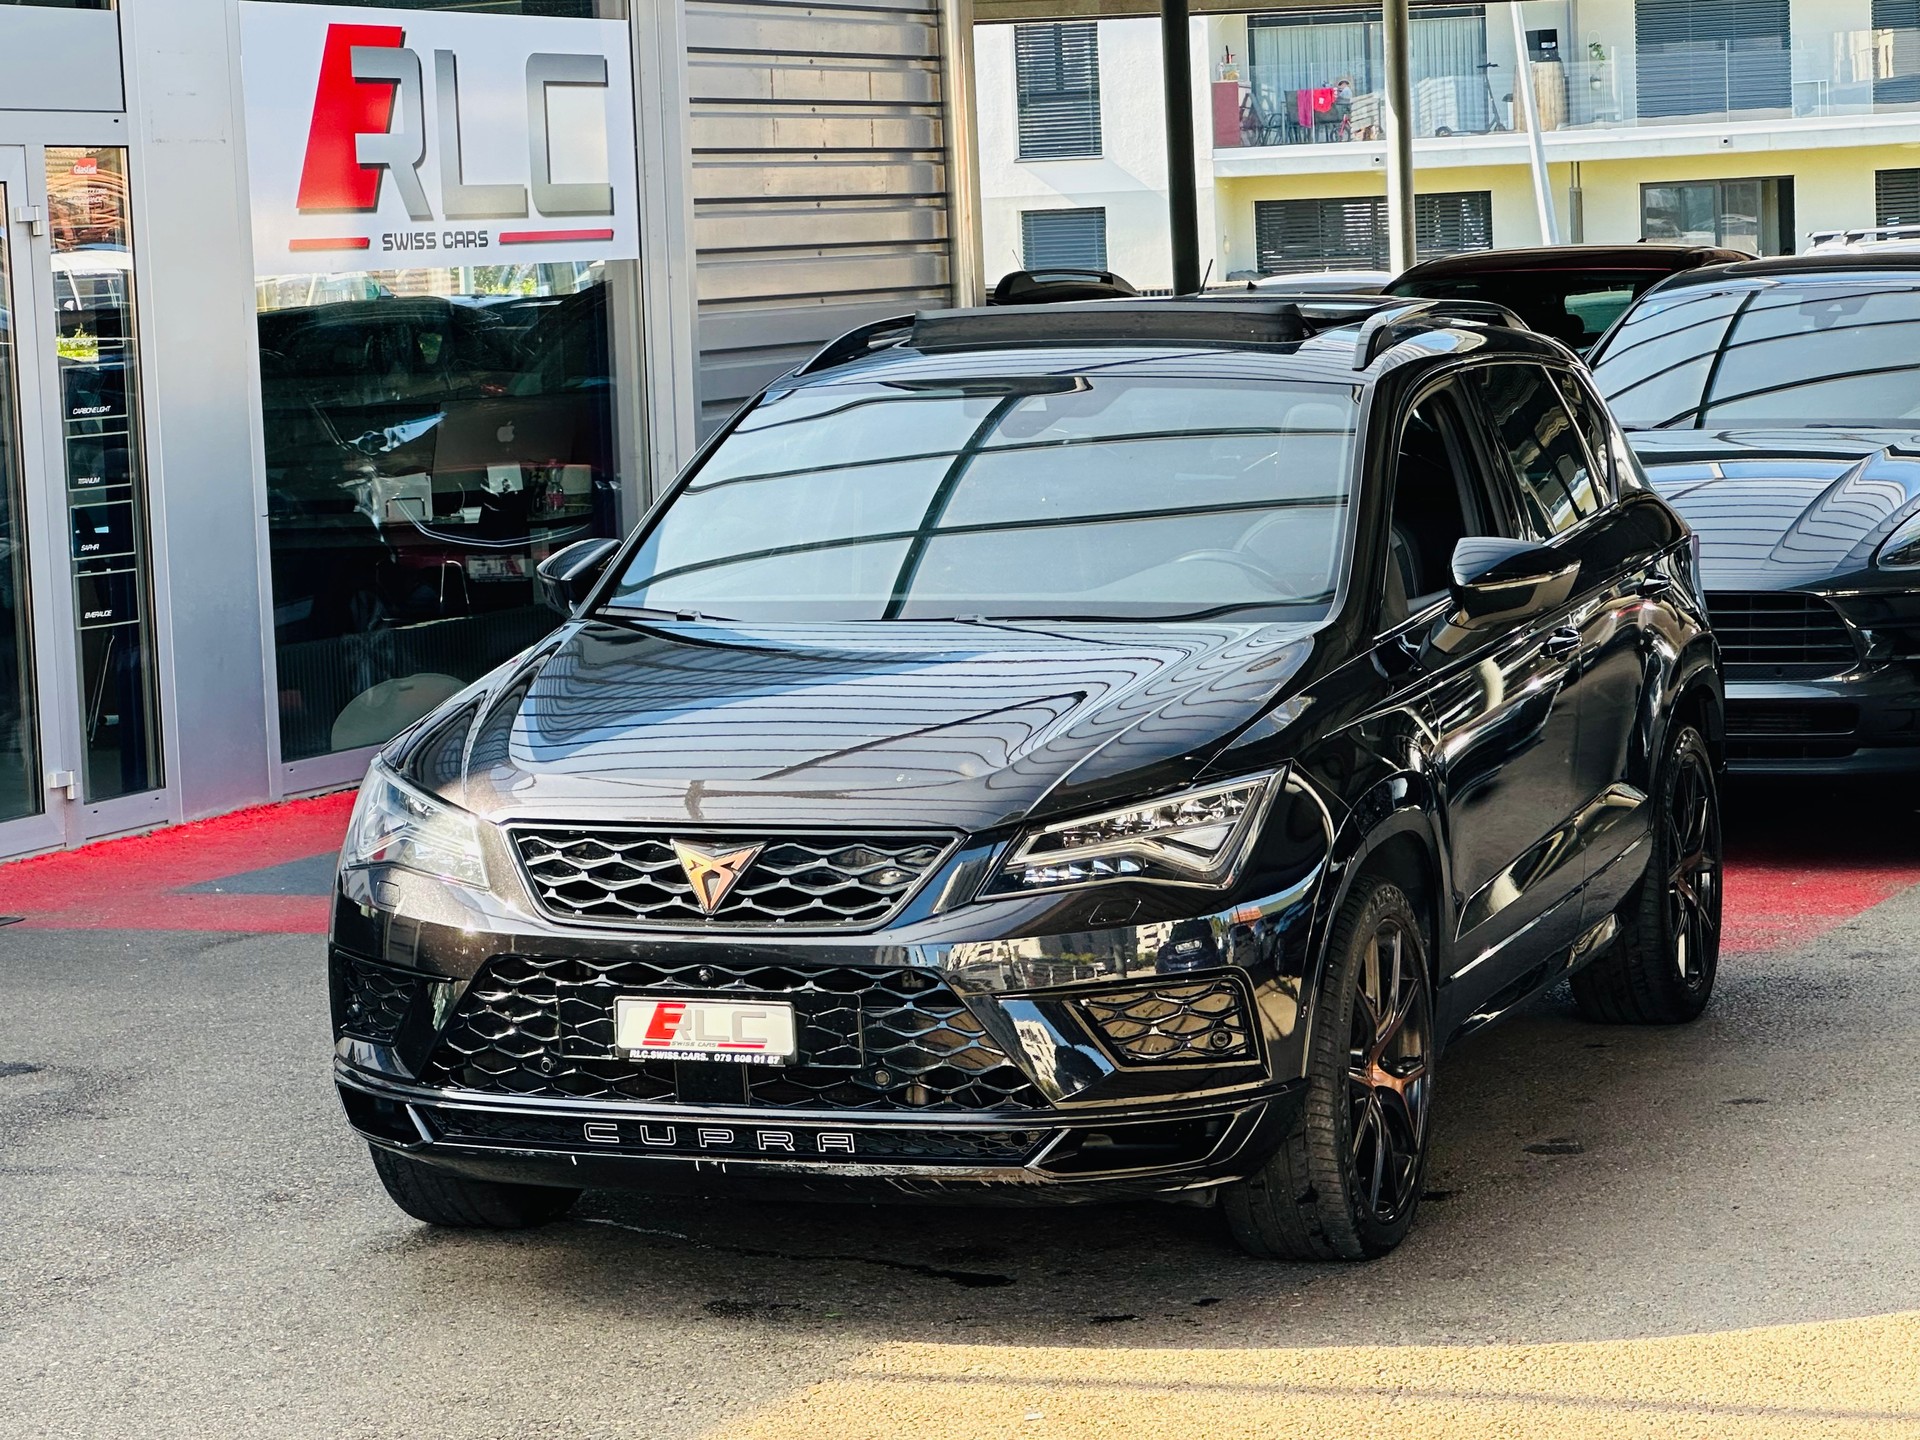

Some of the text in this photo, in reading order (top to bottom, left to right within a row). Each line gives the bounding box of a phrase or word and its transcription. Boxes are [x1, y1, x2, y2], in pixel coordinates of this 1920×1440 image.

[382, 230, 489, 251] SWISS CARS
[645, 1003, 767, 1042] RLC
[714, 1053, 732, 1062] 079
[753, 1055, 765, 1064] 01
[584, 1122, 855, 1153] CUPRA
